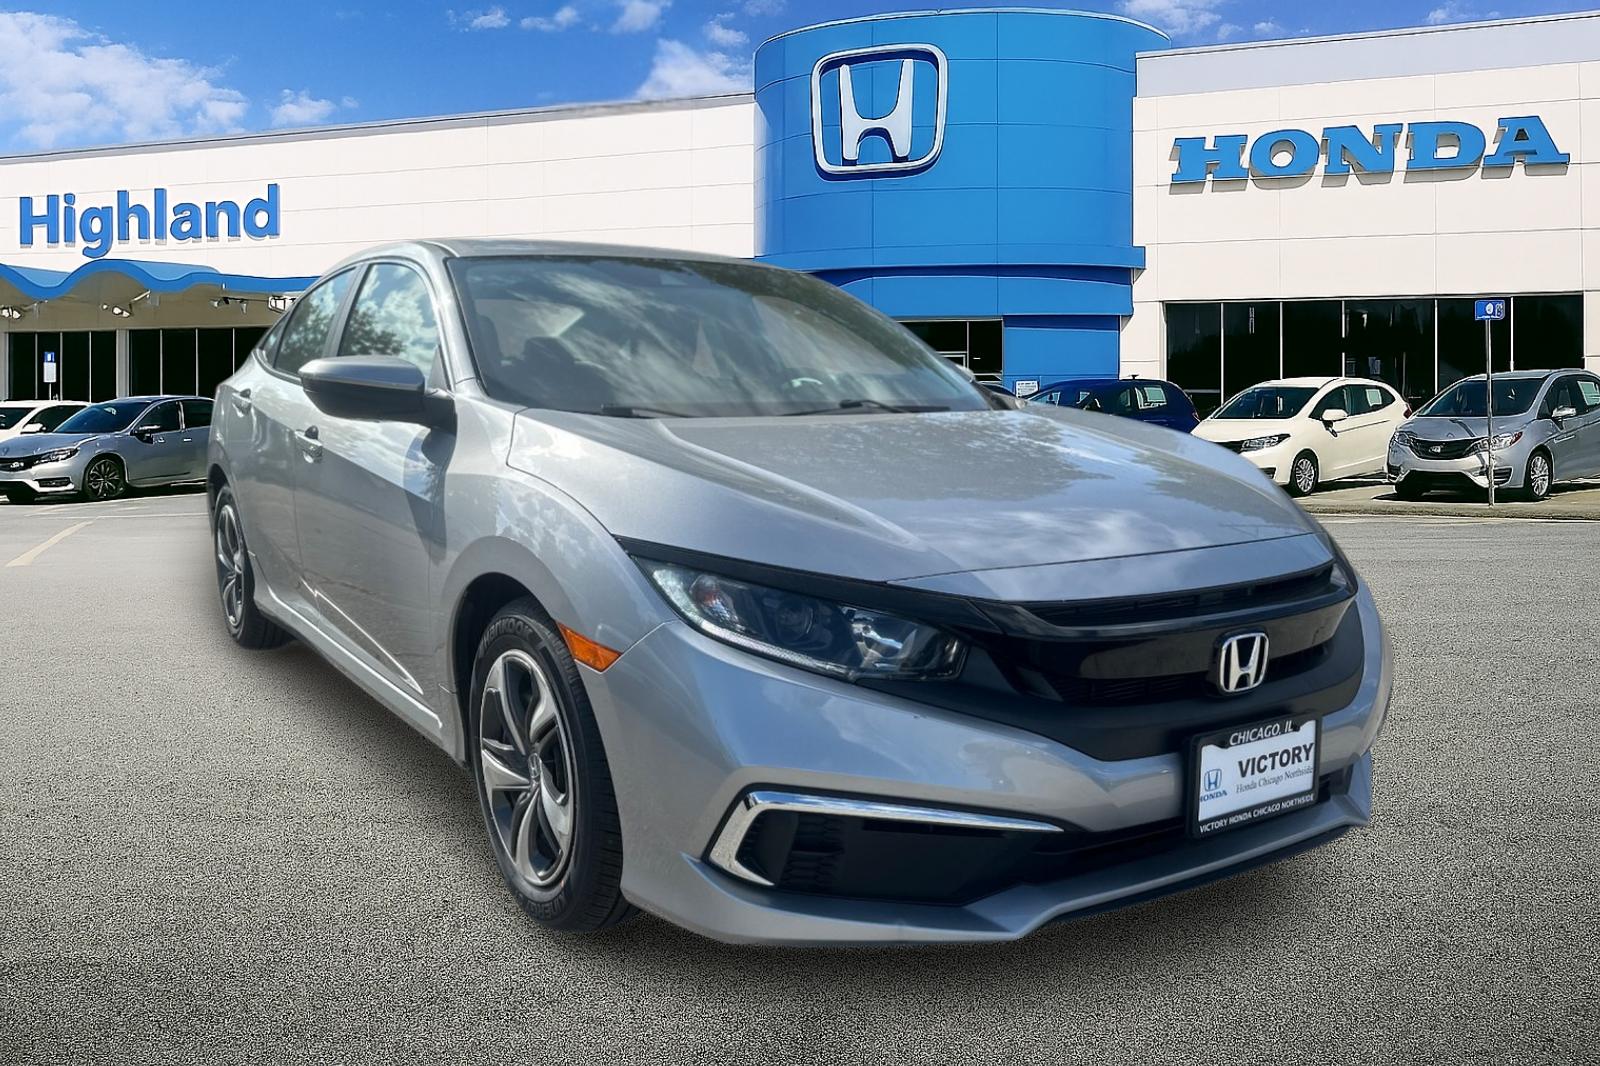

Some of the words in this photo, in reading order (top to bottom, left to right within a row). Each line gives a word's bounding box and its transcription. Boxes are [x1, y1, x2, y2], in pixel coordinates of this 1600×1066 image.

[1171, 115, 1570, 184] HONDA
[20, 183, 280, 258] Highland
[1284, 720, 1294, 733] IL
[1238, 743, 1314, 778] VICTORY
[1236, 780, 1257, 794] Honda
[1258, 773, 1283, 788] Chicago
[1200, 818, 1230, 833] VICTORY
[1229, 811, 1252, 824] HONDA
[1253, 803, 1280, 818] CHICAGO
[1281, 793, 1314, 810] NORTHSIDE
